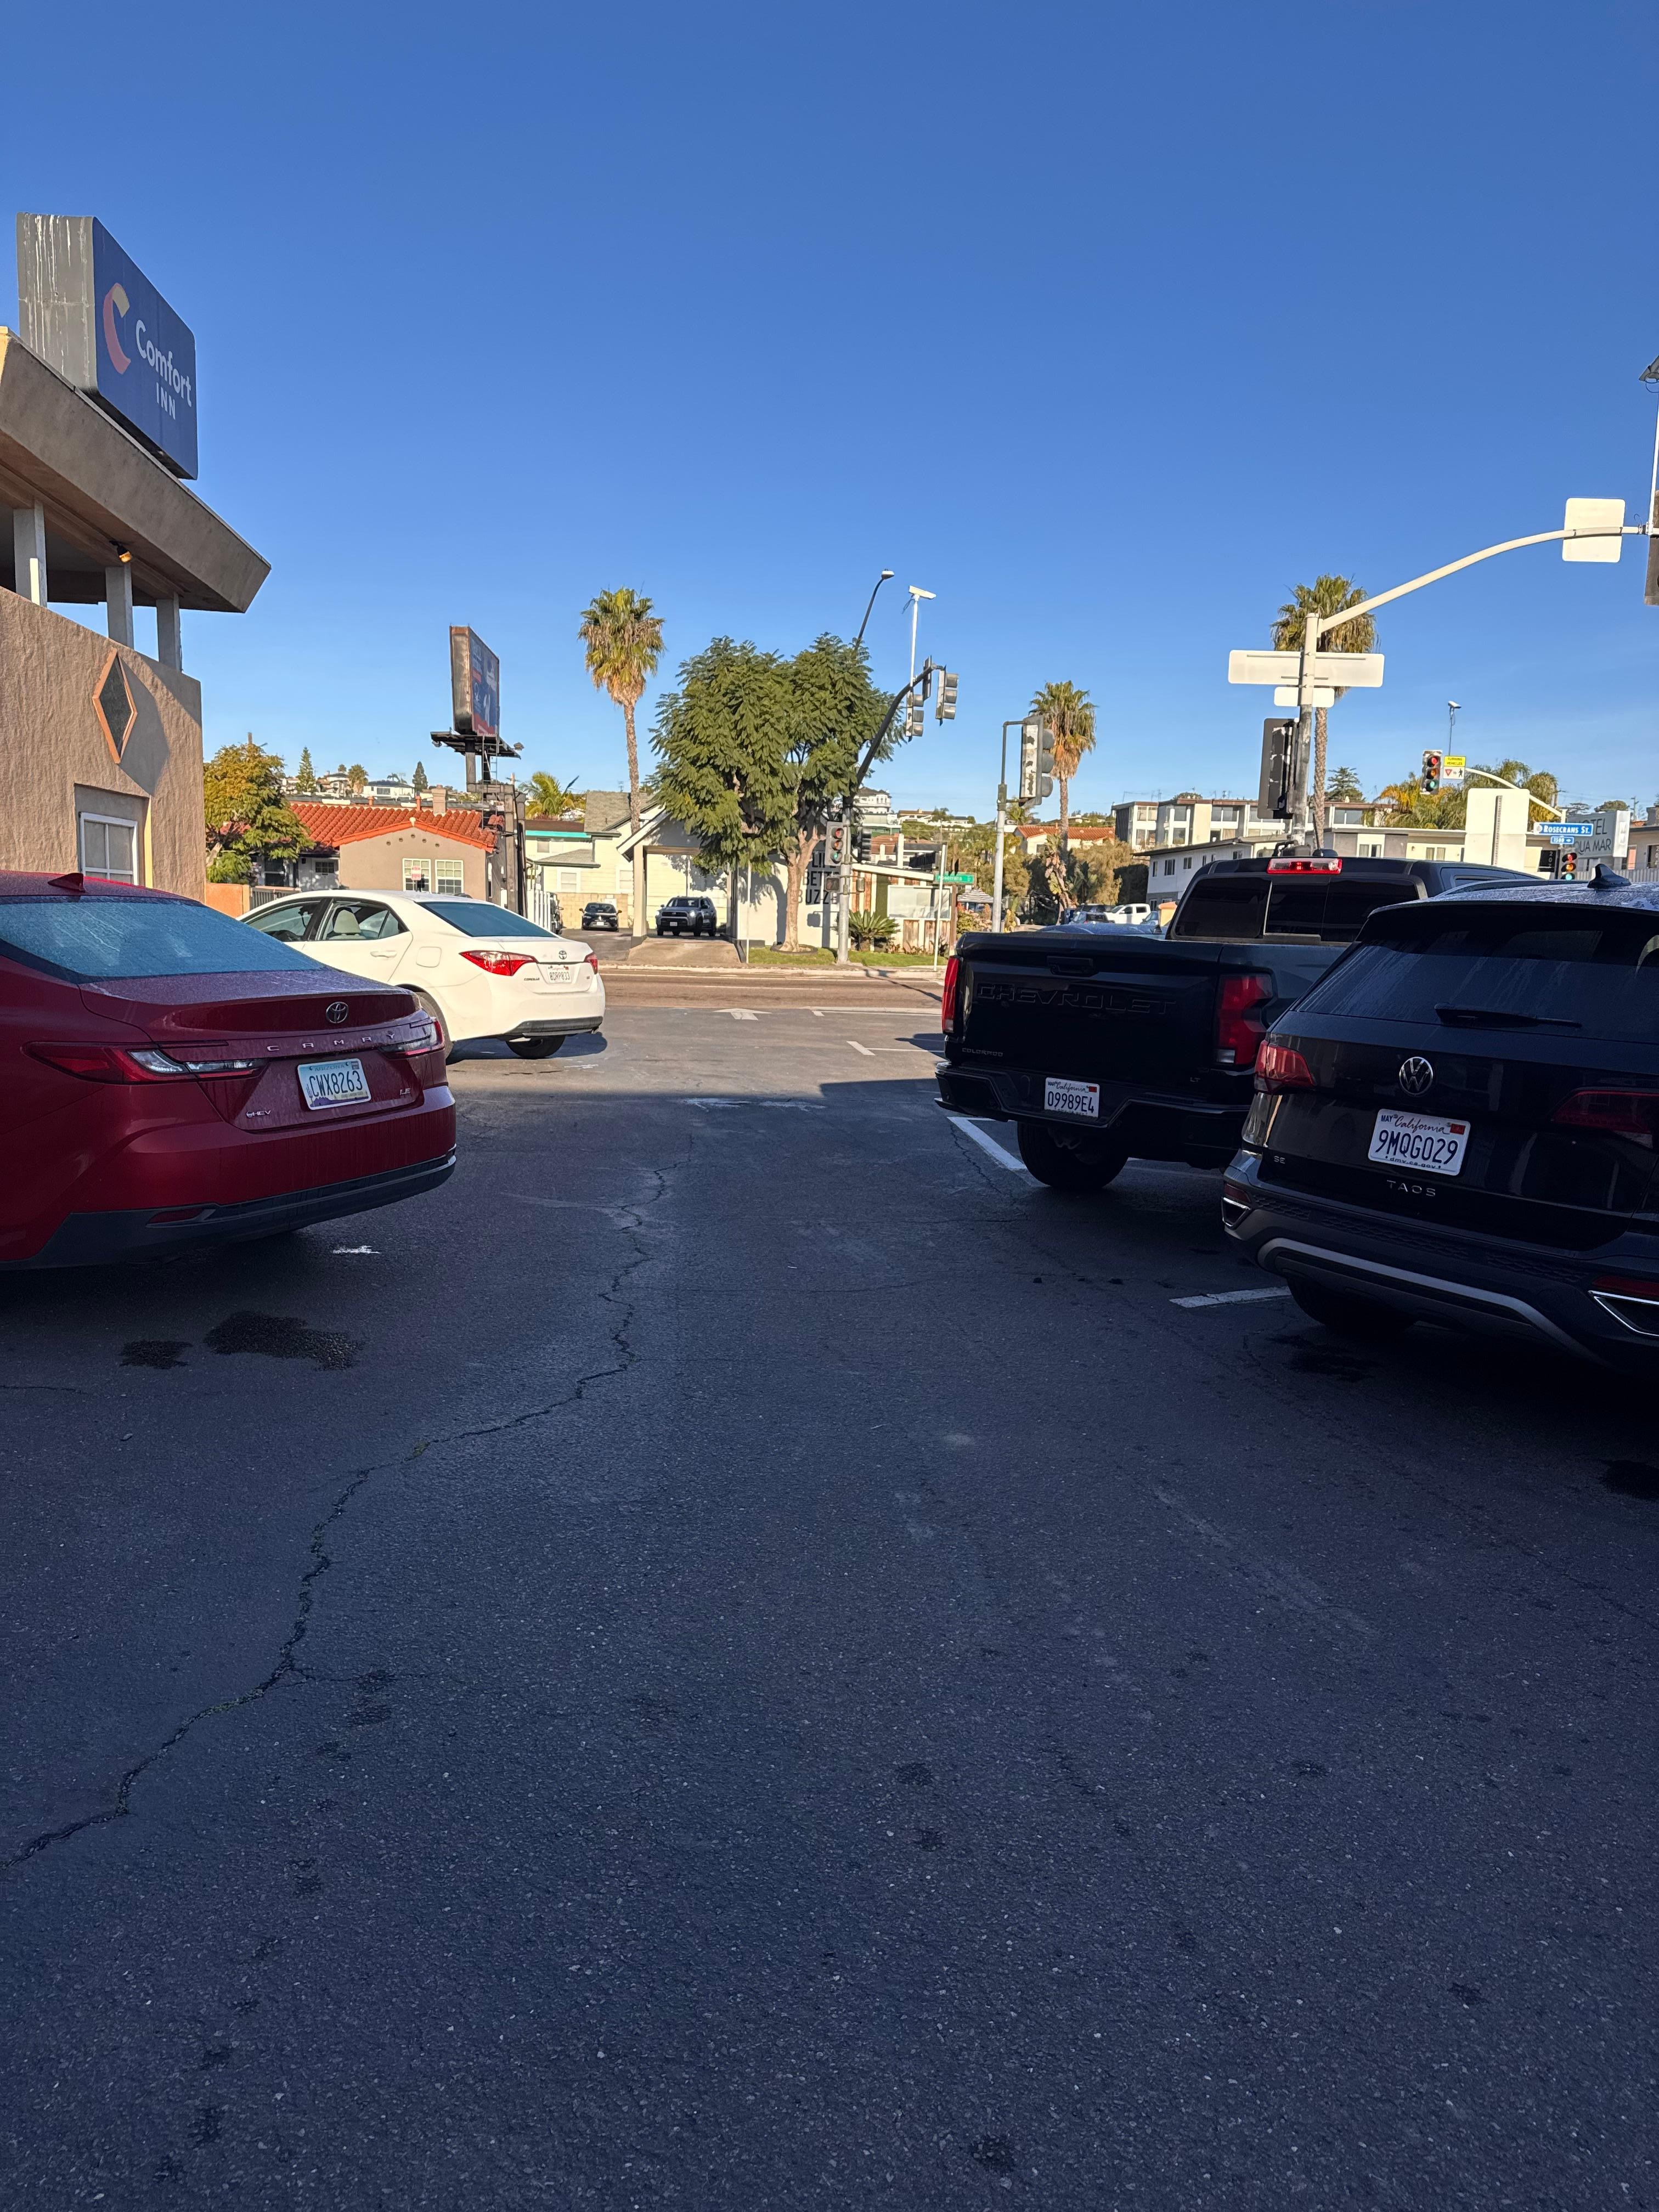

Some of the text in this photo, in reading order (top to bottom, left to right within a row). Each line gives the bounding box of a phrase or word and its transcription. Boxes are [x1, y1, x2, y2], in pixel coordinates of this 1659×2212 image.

[136, 319, 192, 407] Comfort
[156, 382, 176, 420] INN
[1543, 825, 1579, 834] ROSECRANS
[1575, 838, 1612, 855] QUA MAR
[978, 984, 1177, 1014] CHEVROLET
[267, 1032, 396, 1052] CAMRY
[962, 1047, 1003, 1057] COLORADO
[309, 1070, 363, 1097] CWX8263
[1056, 1081, 1089, 1093] California
[1047, 1091, 1094, 1113] 09989E4
[1381, 1114, 1393, 1122] MAY
[1395, 1115, 1450, 1135] California
[1375, 1130, 1458, 1165] 9MQG029
[1274, 1155, 1285, 1164] SE
[1390, 1156, 1436, 1169] dmv.ca.gov
[1386, 1180, 1436, 1197] TAOS
